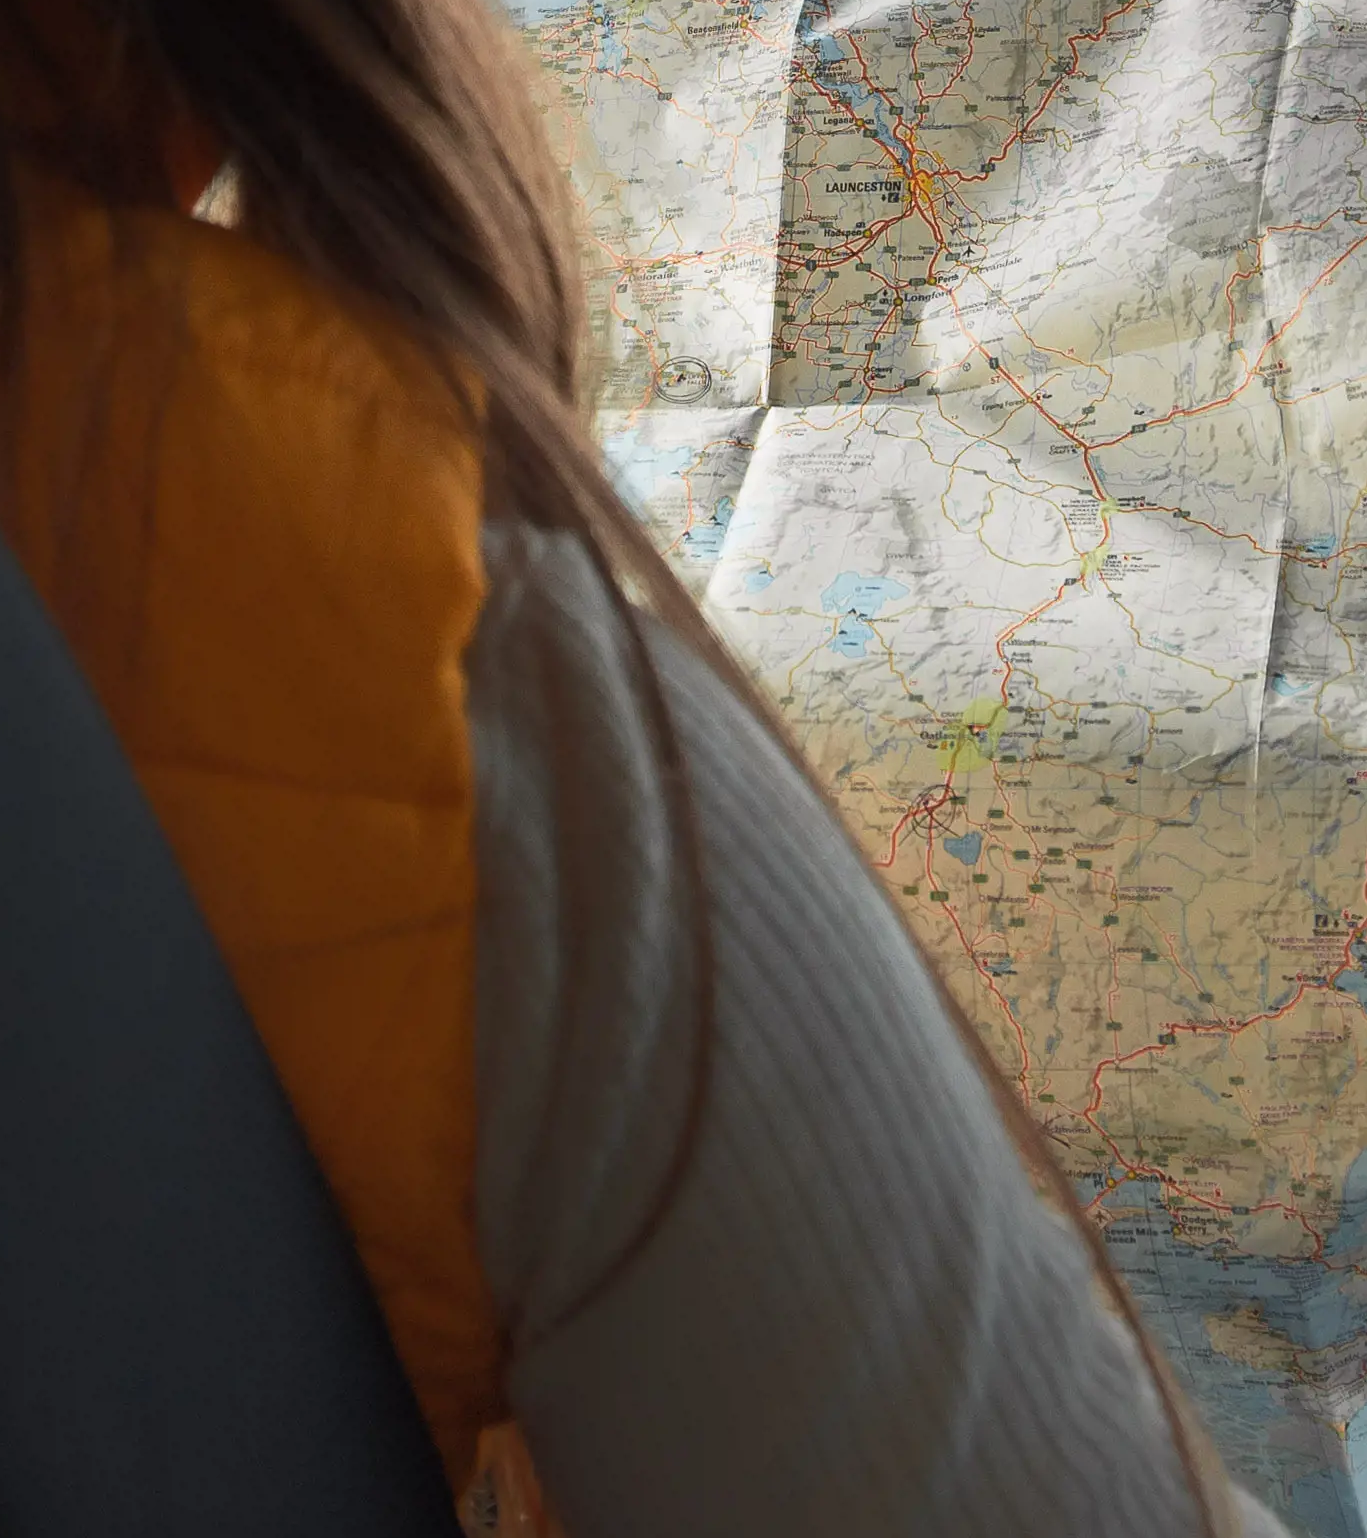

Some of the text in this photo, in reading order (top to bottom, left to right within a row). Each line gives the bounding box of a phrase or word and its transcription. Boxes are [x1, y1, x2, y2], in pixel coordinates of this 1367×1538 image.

[688, 21, 738, 35] Beaconsfield
[826, 182, 901, 192] LAUNCESTON
[824, 229, 861, 237] Hadspen
[937, 274, 959, 284] Perth
[904, 289, 953, 304] Longford
[990, 376, 1001, 384] 57
[1181, 1215, 1218, 1225] Dodges
[1137, 1228, 1158, 1236] Mile
[1182, 1224, 1207, 1234] Ferry
[1104, 1235, 1136, 1244] Beach
